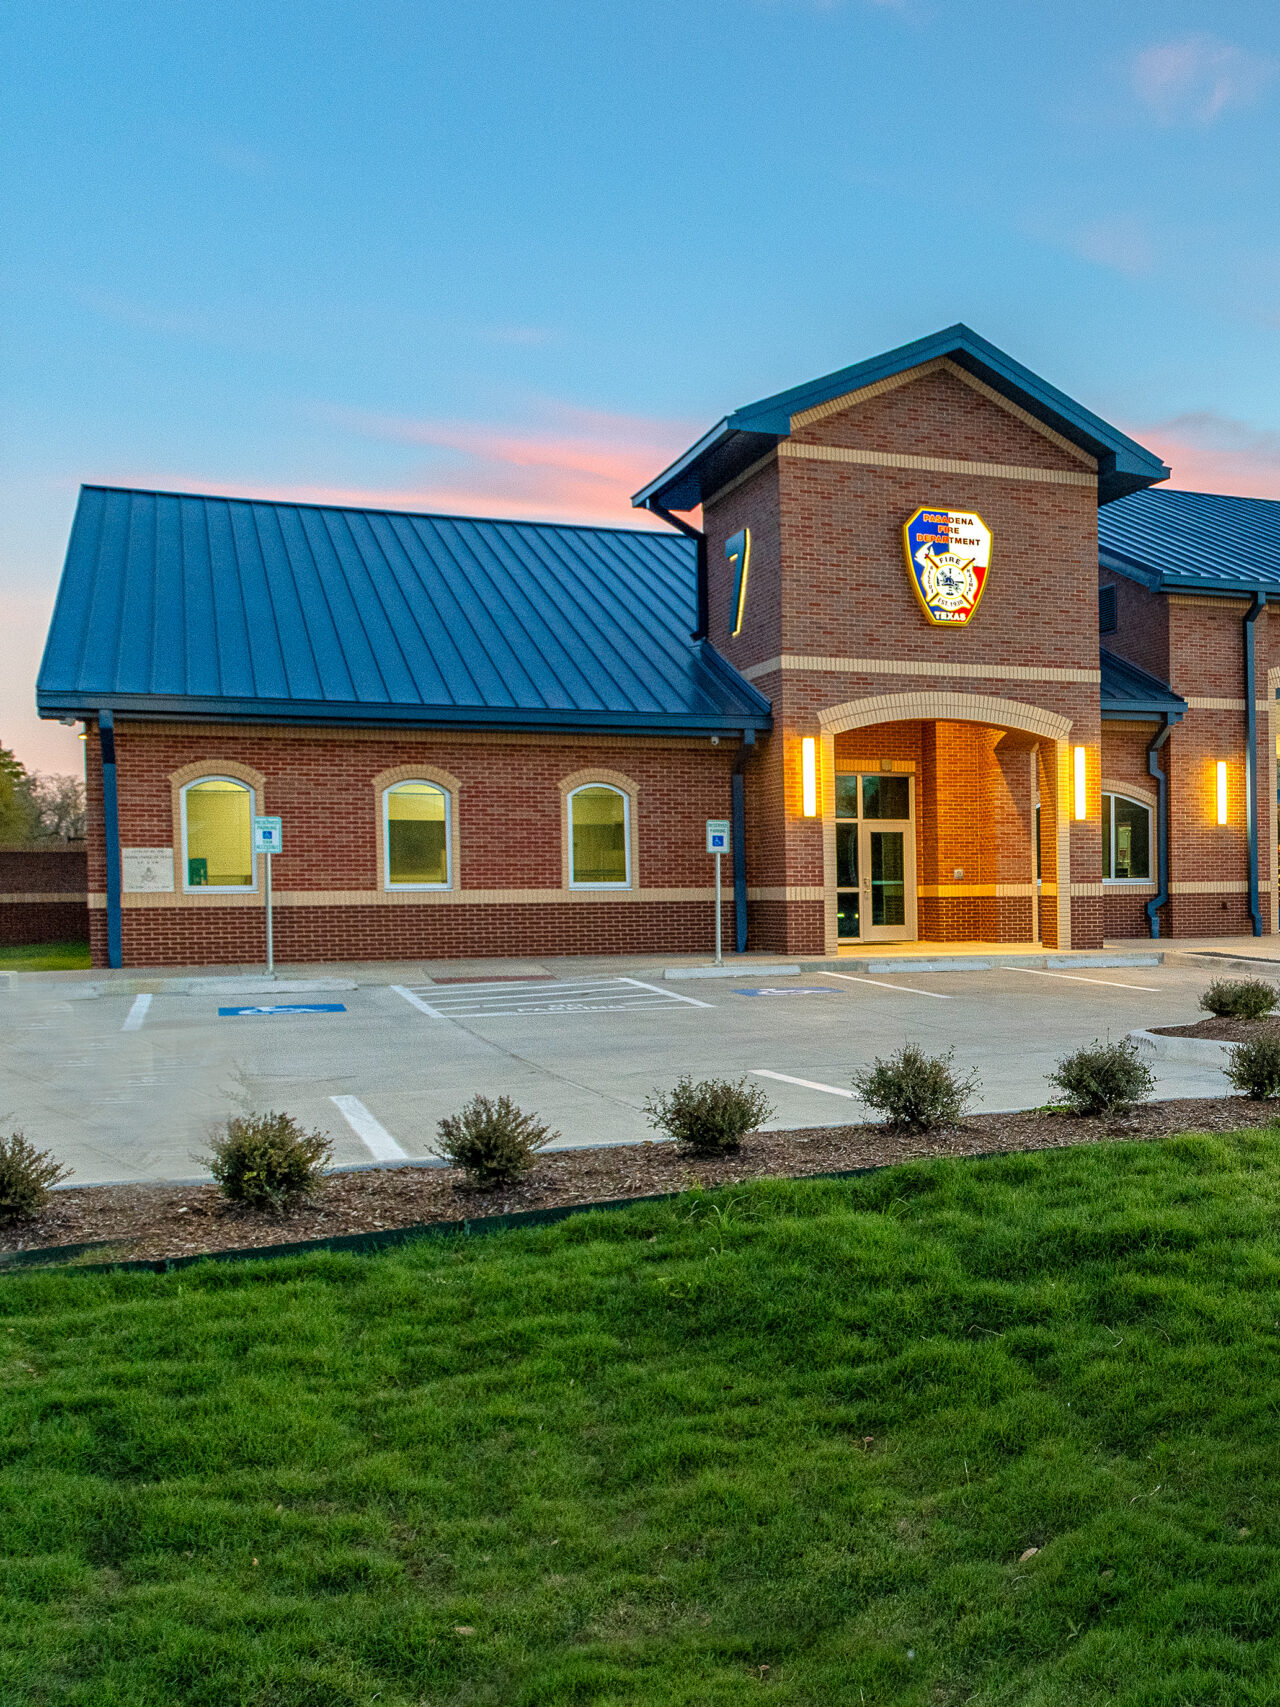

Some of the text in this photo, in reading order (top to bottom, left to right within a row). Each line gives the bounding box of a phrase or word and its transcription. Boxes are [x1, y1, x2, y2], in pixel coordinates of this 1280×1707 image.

[923, 514, 974, 526] PASADENA
[938, 525, 959, 535] FIRE
[916, 533, 981, 546] DEPARTMENT
[939, 556, 961, 566] FIRE
[934, 611, 966, 621] TEXAS
